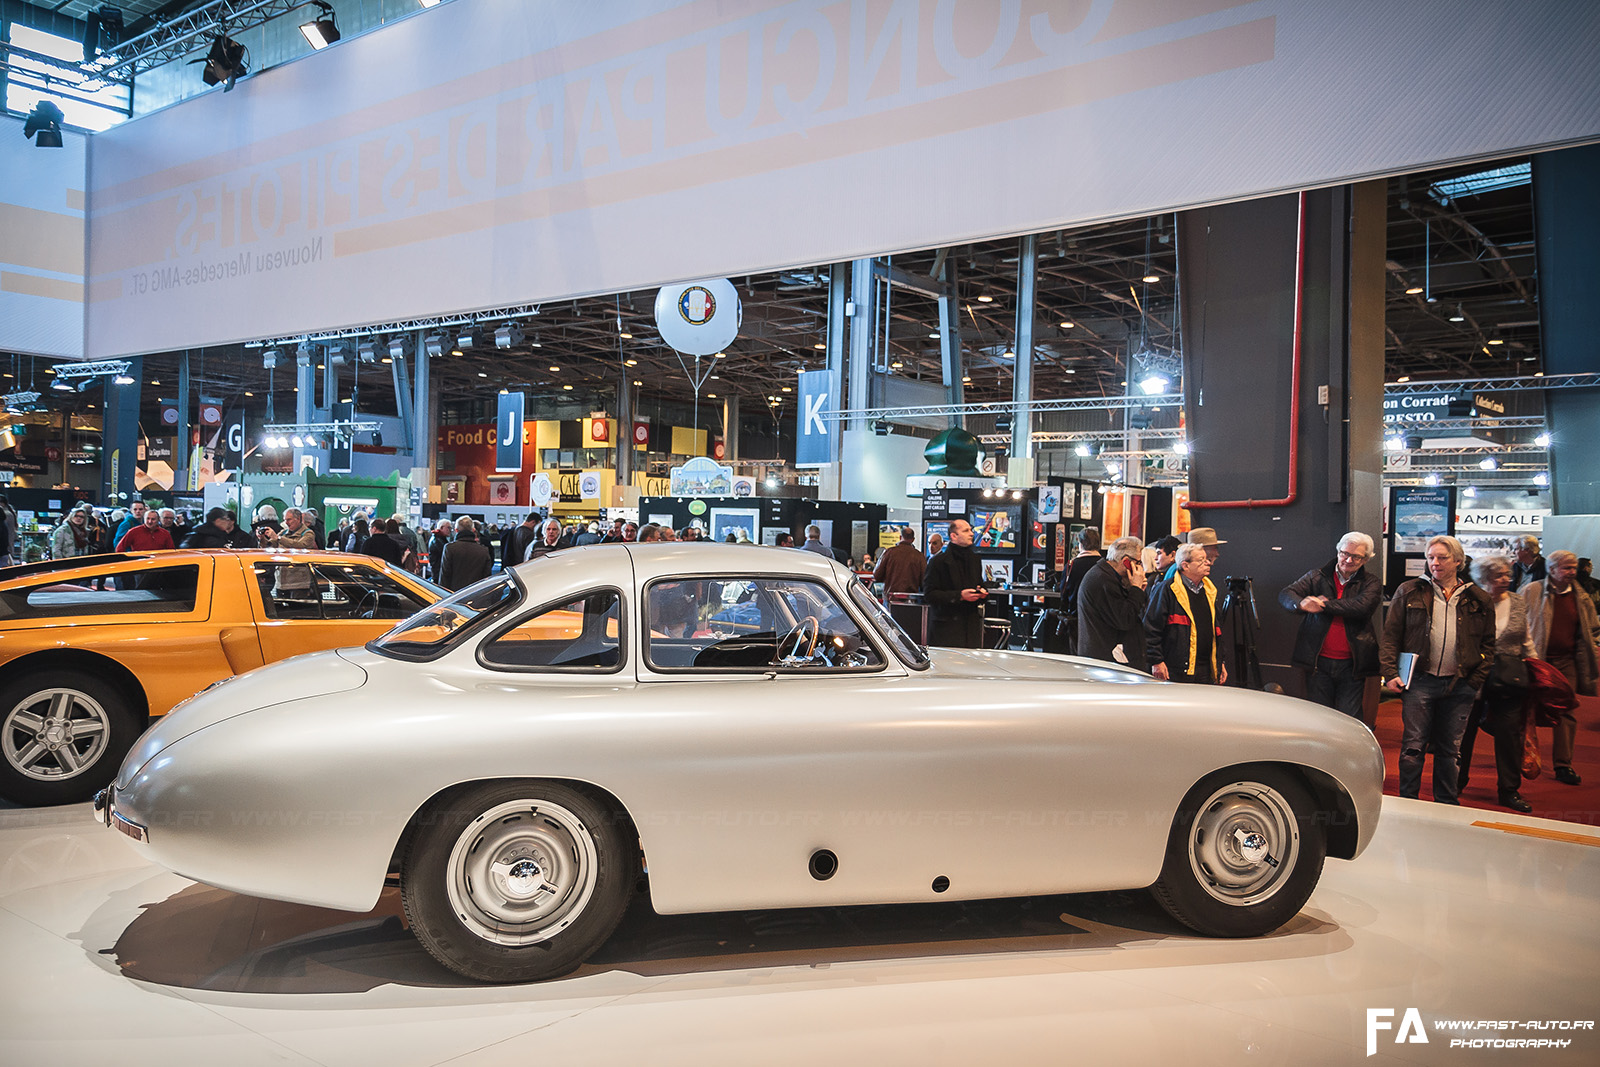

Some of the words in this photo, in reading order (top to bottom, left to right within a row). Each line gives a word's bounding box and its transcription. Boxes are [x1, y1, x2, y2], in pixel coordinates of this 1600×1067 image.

[503, 411, 515, 446] J
[805, 393, 828, 435] K
[228, 423, 242, 452] G
[447, 428, 483, 445] Food
[1464, 515, 1540, 526] AMICALE
